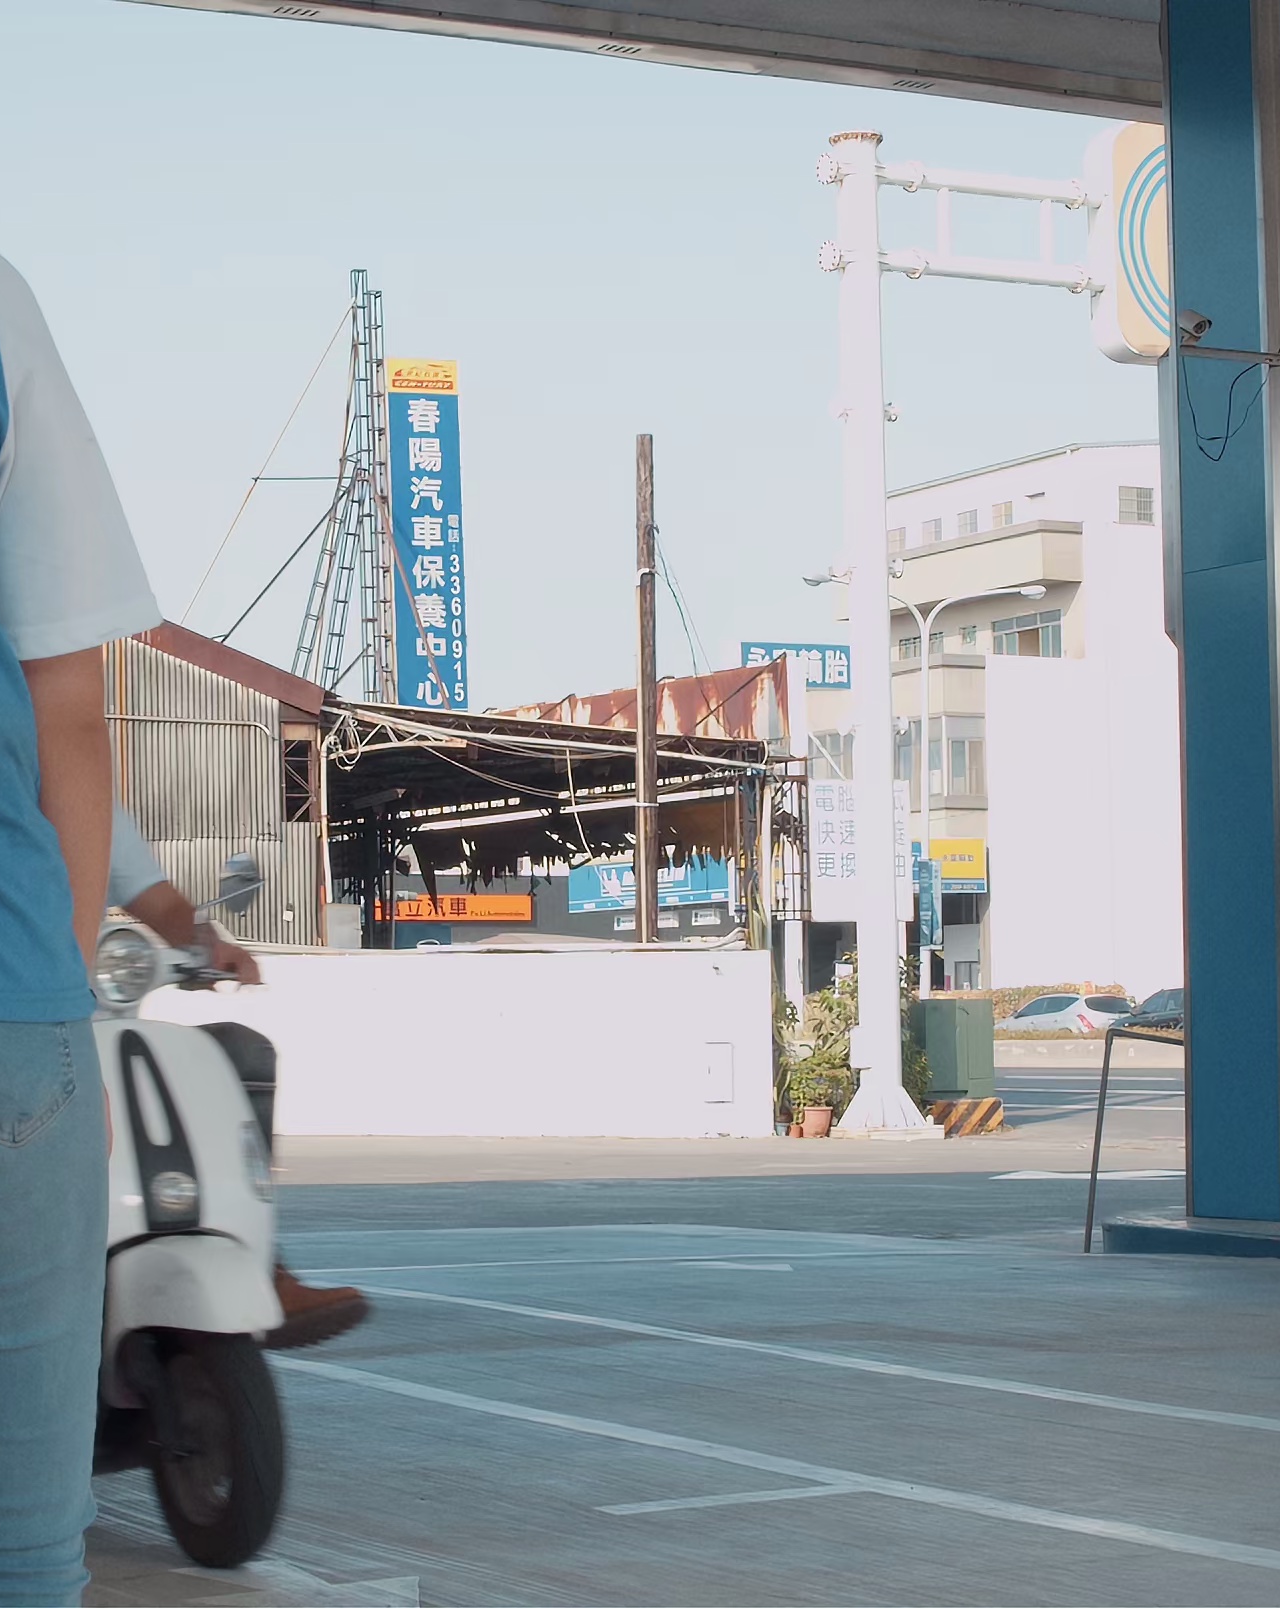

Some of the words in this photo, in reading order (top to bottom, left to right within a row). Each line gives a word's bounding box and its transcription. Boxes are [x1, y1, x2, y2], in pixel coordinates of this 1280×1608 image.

[407, 398, 450, 706] 春陽汽車保養中心
[449, 554, 465, 702] 3360915
